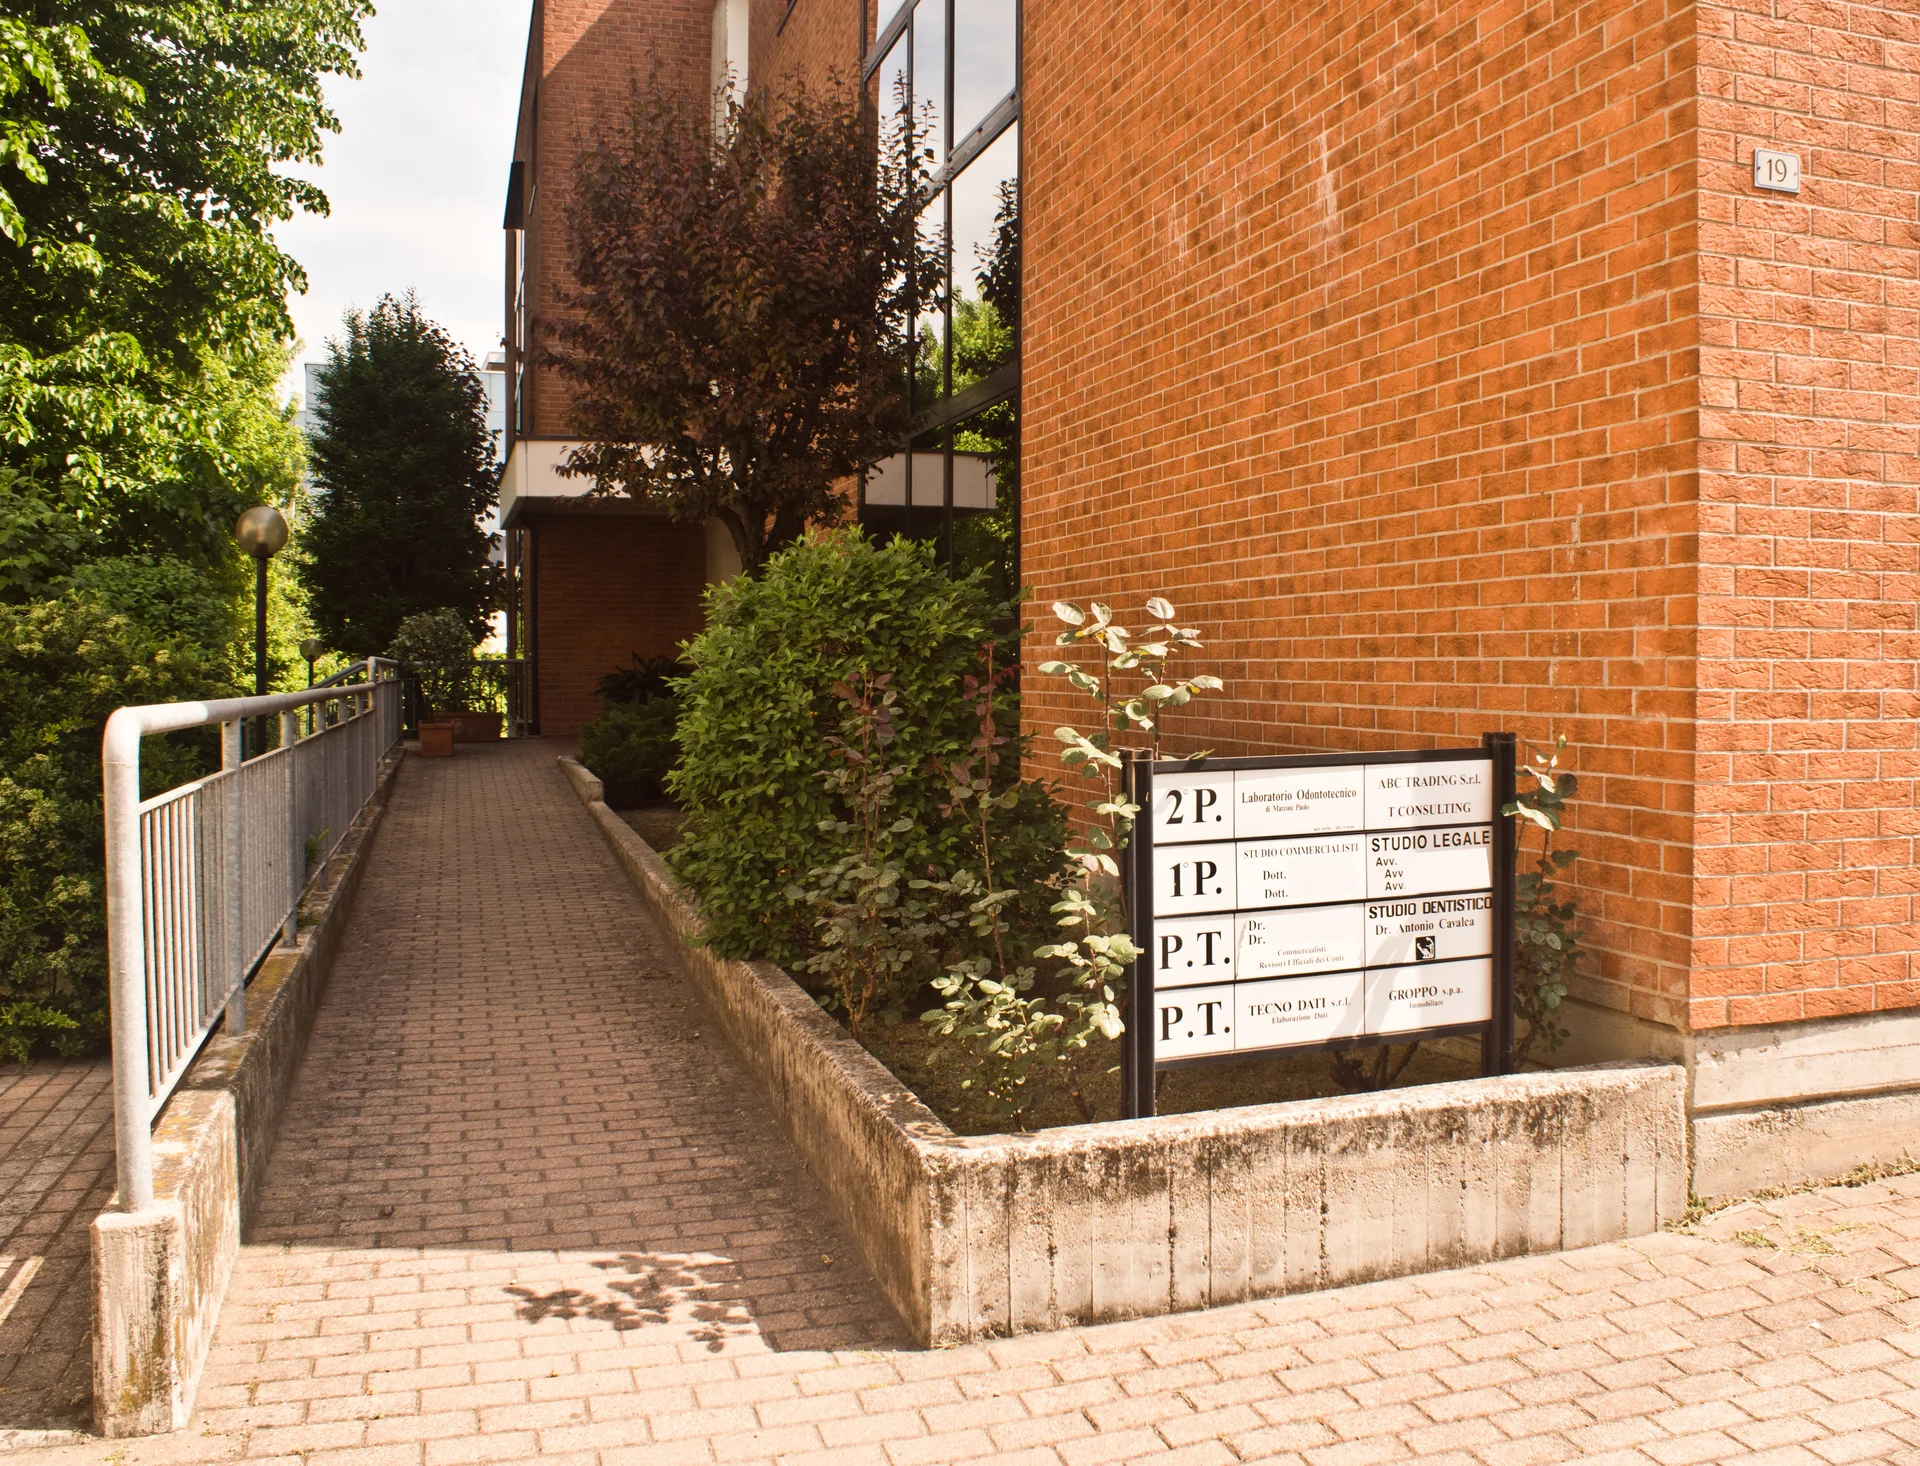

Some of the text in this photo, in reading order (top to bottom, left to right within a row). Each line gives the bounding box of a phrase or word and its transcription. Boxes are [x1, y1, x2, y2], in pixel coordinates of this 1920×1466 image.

[1766, 158, 1787, 183] 19
[1378, 773, 1482, 790] ABC TRADING S.r.l.
[1241, 787, 1357, 804] Laboratorio Odontotecnico
[1272, 804, 1294, 812] Marconi
[1295, 803, 1310, 811] Paolo
[1388, 802, 1472, 818] T CONSULTING
[1371, 830, 1491, 853] STUDIO LEGALE
[1243, 842, 1359, 859] STUDIO COMMERCIALISTI
[1375, 857, 1398, 867] Avv.
[1263, 870, 1287, 881] Dott.
[1264, 888, 1289, 899] Dott.
[1368, 896, 1492, 919] STUDIO DENTISTICO
[1248, 920, 1266, 932] Dr.
[1375, 924, 1392, 936] Dr.
[1397, 920, 1434, 934] Antonio
[1248, 934, 1266, 946] Dr.
[1158, 931, 1231, 971] P.T.
[1277, 945, 1327, 957] Commercialisti
[1259, 954, 1345, 970] Revisori Ufficiali dei Conti
[1388, 985, 1464, 1001] GROPPO s.p.a.
[1247, 996, 1352, 1017] TECNO DATI s.r.l.
[1409, 999, 1444, 1009] Immobiliare
[1158, 1000, 1231, 1042] P.T.
[1271, 1011, 1329, 1025] Elaborazione Dati
